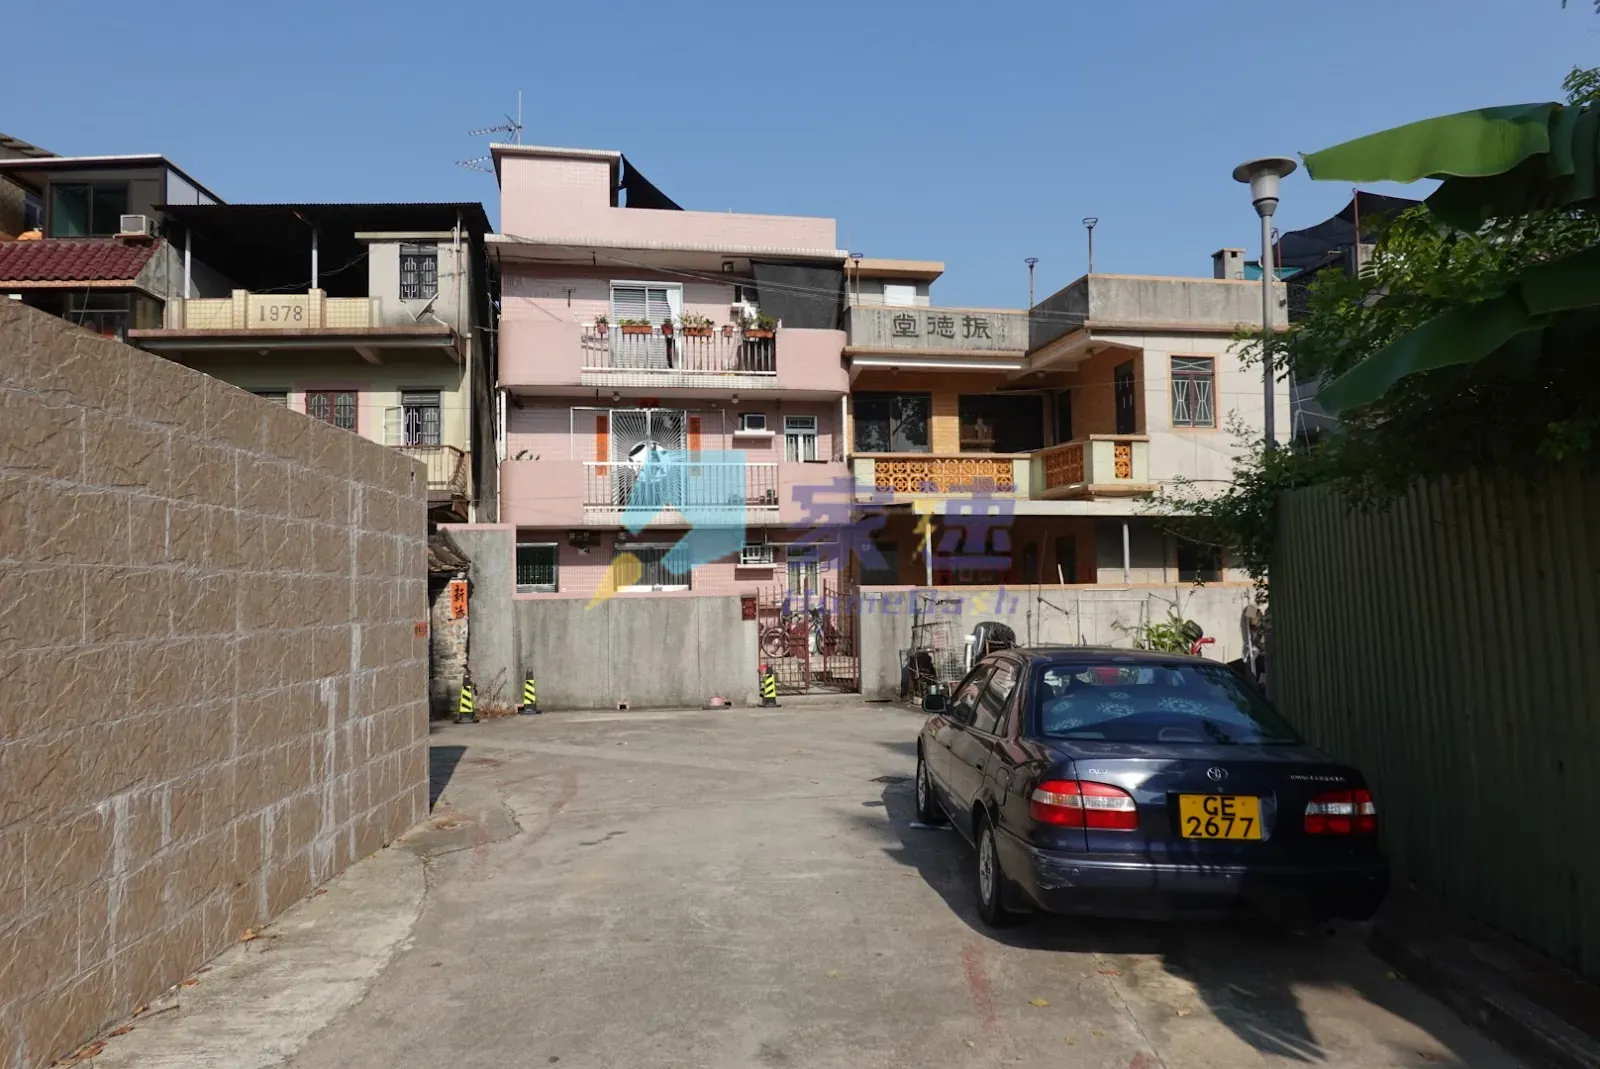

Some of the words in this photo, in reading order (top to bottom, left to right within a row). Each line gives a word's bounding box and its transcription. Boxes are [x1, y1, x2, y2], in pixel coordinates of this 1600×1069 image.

[259, 305, 303, 321] 1978
[1203, 796, 1236, 817] GE
[1186, 816, 1254, 838] 2677
